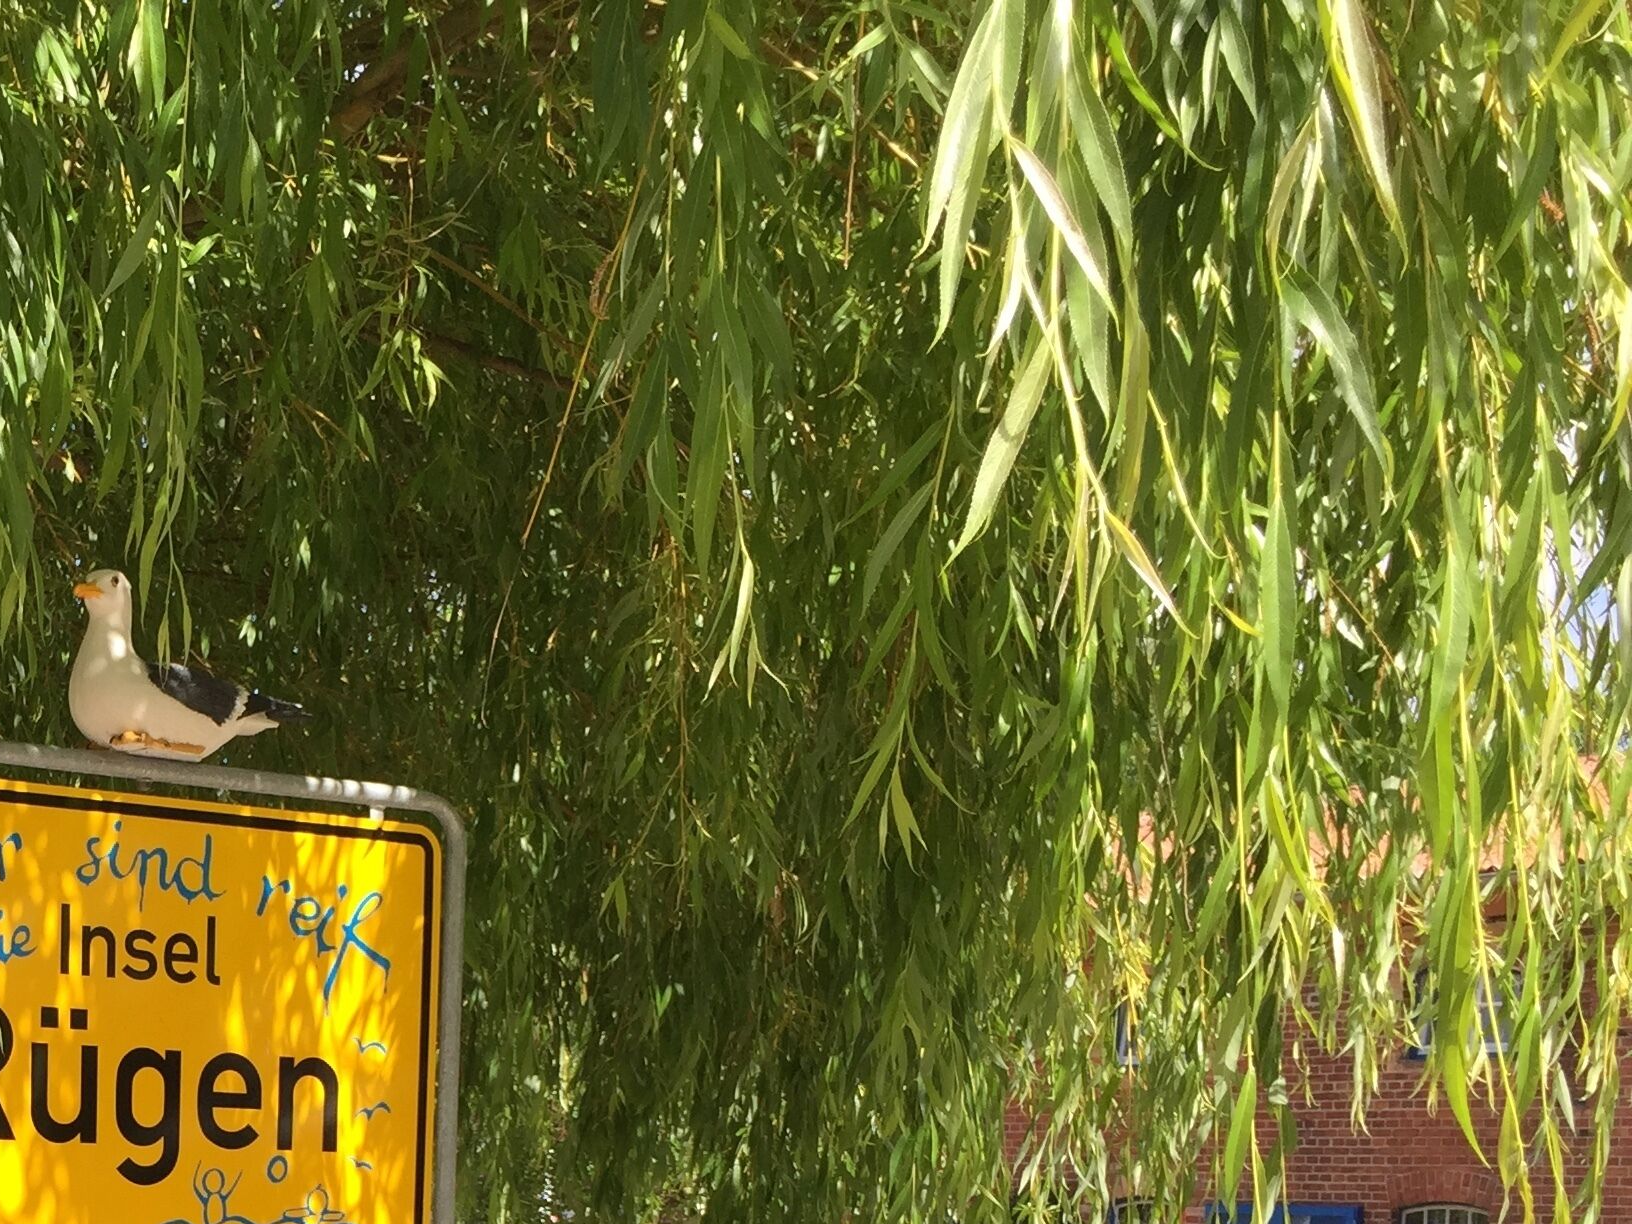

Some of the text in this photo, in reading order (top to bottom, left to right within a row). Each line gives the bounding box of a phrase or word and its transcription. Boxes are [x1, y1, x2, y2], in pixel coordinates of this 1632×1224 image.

[60, 903, 221, 986] Insel
[75, 820, 227, 908] sind
[256, 874, 392, 1010] reif
